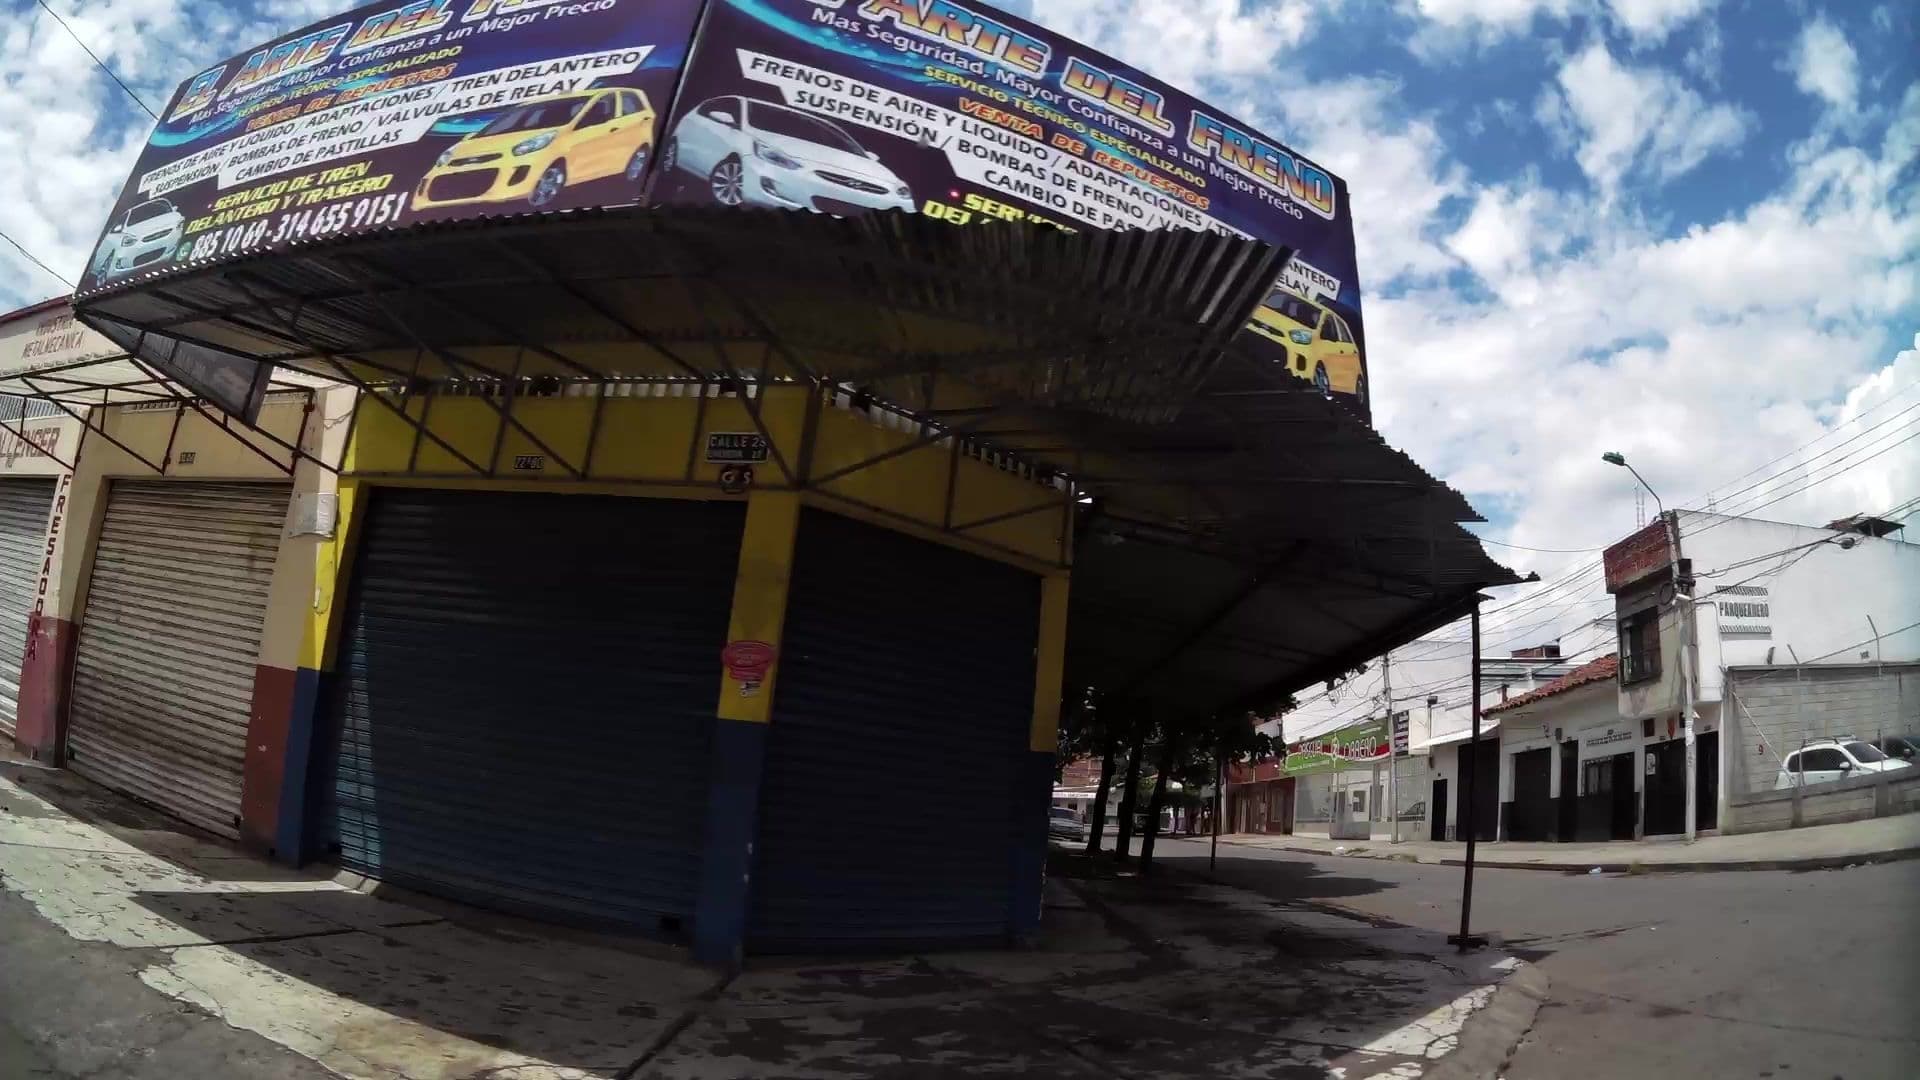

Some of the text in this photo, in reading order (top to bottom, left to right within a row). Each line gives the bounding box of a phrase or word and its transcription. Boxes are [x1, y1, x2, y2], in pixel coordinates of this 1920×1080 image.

[217, 22, 352, 101] ARTE
[341, 0, 453, 55] DEL
[286, 63, 337, 87] Mayor
[339, 38, 426, 69] Confianza
[428, 36, 441, 46] a
[446, 26, 473, 41] un
[477, 11, 540, 33] Mejor
[544, 0, 616, 20] Precio
[347, 45, 463, 81] ESPECIALIZADO
[183, 156, 200, 169] DE
[199, 145, 229, 163] AIRE
[238, 122, 295, 149] LIQUIDO
[305, 86, 435, 128] ADAPTACIONES
[451, 73, 501, 93] TREN
[506, 51, 641, 82] DELANTERO
[228, 140, 286, 168] BOMBAS
[287, 135, 309, 152] DE
[309, 120, 363, 147] FRENO
[376, 94, 473, 127] VALVULAS
[479, 89, 505, 105] DE
[511, 78, 583, 99] RELAY
[304, 93, 336, 113] DE
[336, 63, 458, 103] REPUESTOS
[811, 7, 861, 33] Mas
[995, 69, 1065, 105] Mayor
[1067, 97, 1164, 151] Confianza
[1167, 144, 1178, 156] a
[1182, 150, 1206, 171] un
[1208, 161, 1257, 197] Mejor
[1258, 187, 1304, 221] Precio
[924, 64, 1009, 103] SERVICIO
[1089, 129, 1207, 188] ESPECIALIZADO
[235, 129, 402, 181] CAMBIO DE PASTILLAS
[749, 57, 846, 93] FRENOS
[850, 83, 881, 103] DE
[884, 95, 938, 123] AIRE
[943, 111, 958, 127] Y
[961, 119, 1049, 161] LIQUIDO
[1065, 159, 1202, 226] ADAPTACIONES
[795, 89, 938, 143] SUSPENSIÓN
[958, 139, 1047, 181] BOMBAS
[1052, 172, 1077, 193] DE
[1083, 182, 1145, 220] FRENO
[958, 96, 1210, 211] VENTA DE REPUESTOS
[1060, 56, 1175, 138] DEL
[1187, 109, 1336, 220] FRENO
[185, 173, 394, 235] DELANTERO Y TRASERO
[212, 161, 373, 211] SERVICIO DE TREN
[272, 209, 313, 243] 314
[310, 201, 354, 235] 655
[351, 191, 409, 228] 9151
[984, 169, 1068, 210] CAMBIO
[1072, 201, 1098, 222] DE
[1276, 274, 1310, 298] ELAY
[711, 436, 749, 448] CALLE
